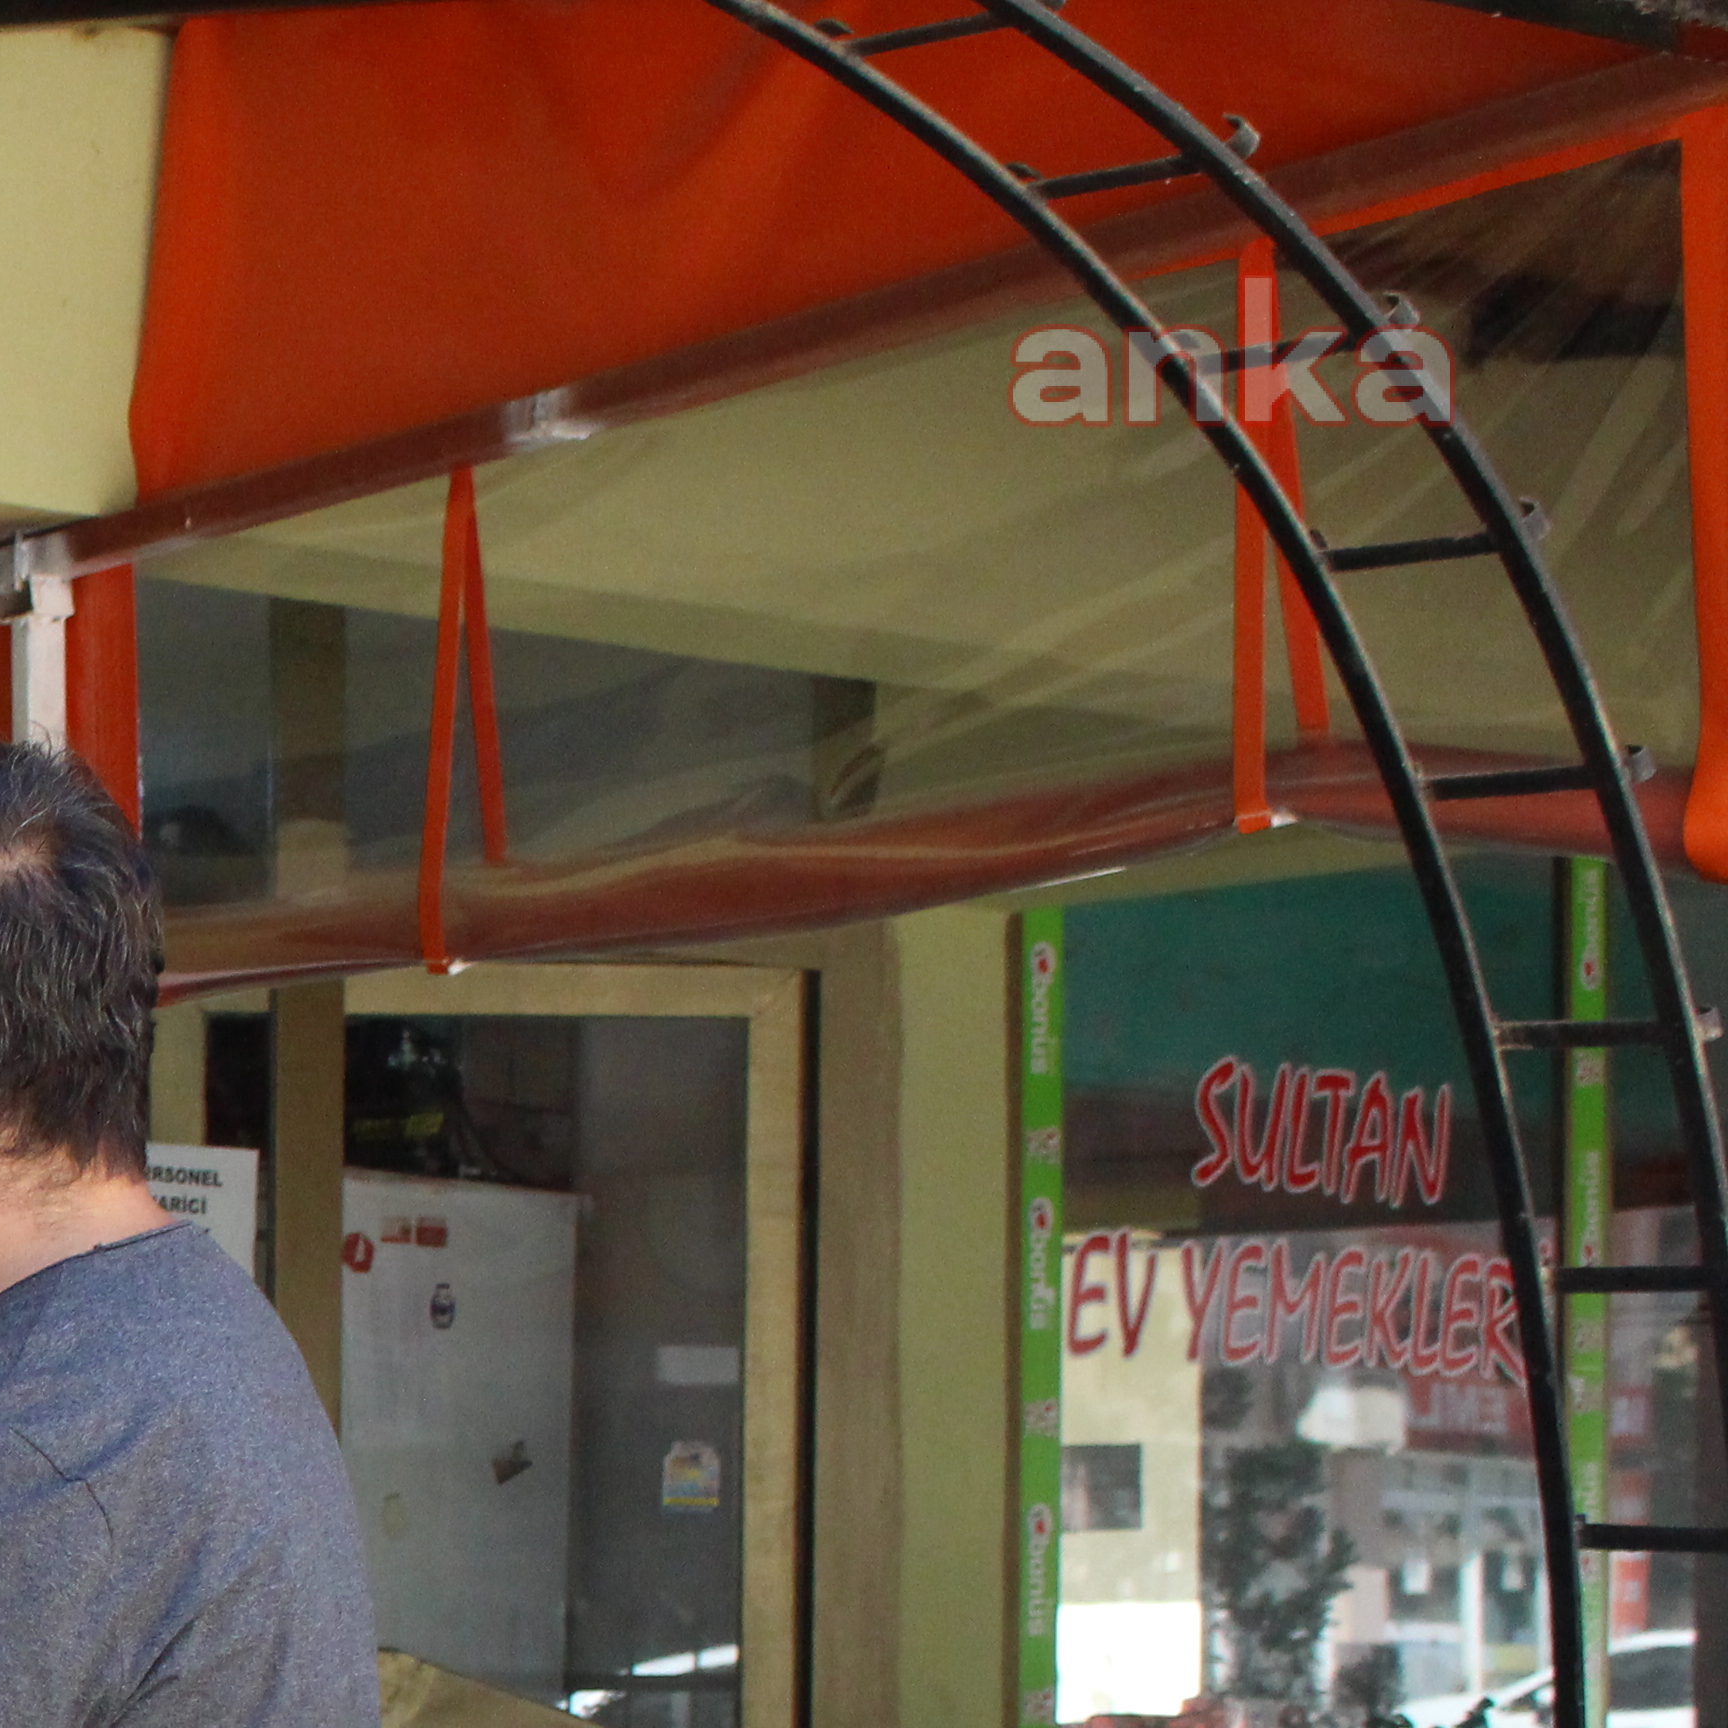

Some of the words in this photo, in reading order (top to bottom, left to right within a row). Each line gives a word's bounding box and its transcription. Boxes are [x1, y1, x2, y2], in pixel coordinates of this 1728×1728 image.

[1191, 1055, 1453, 1207] SULTAN
[1066, 1228, 1157, 1358] EV
[1180, 1234, 1553, 1390] YEMEKLER
